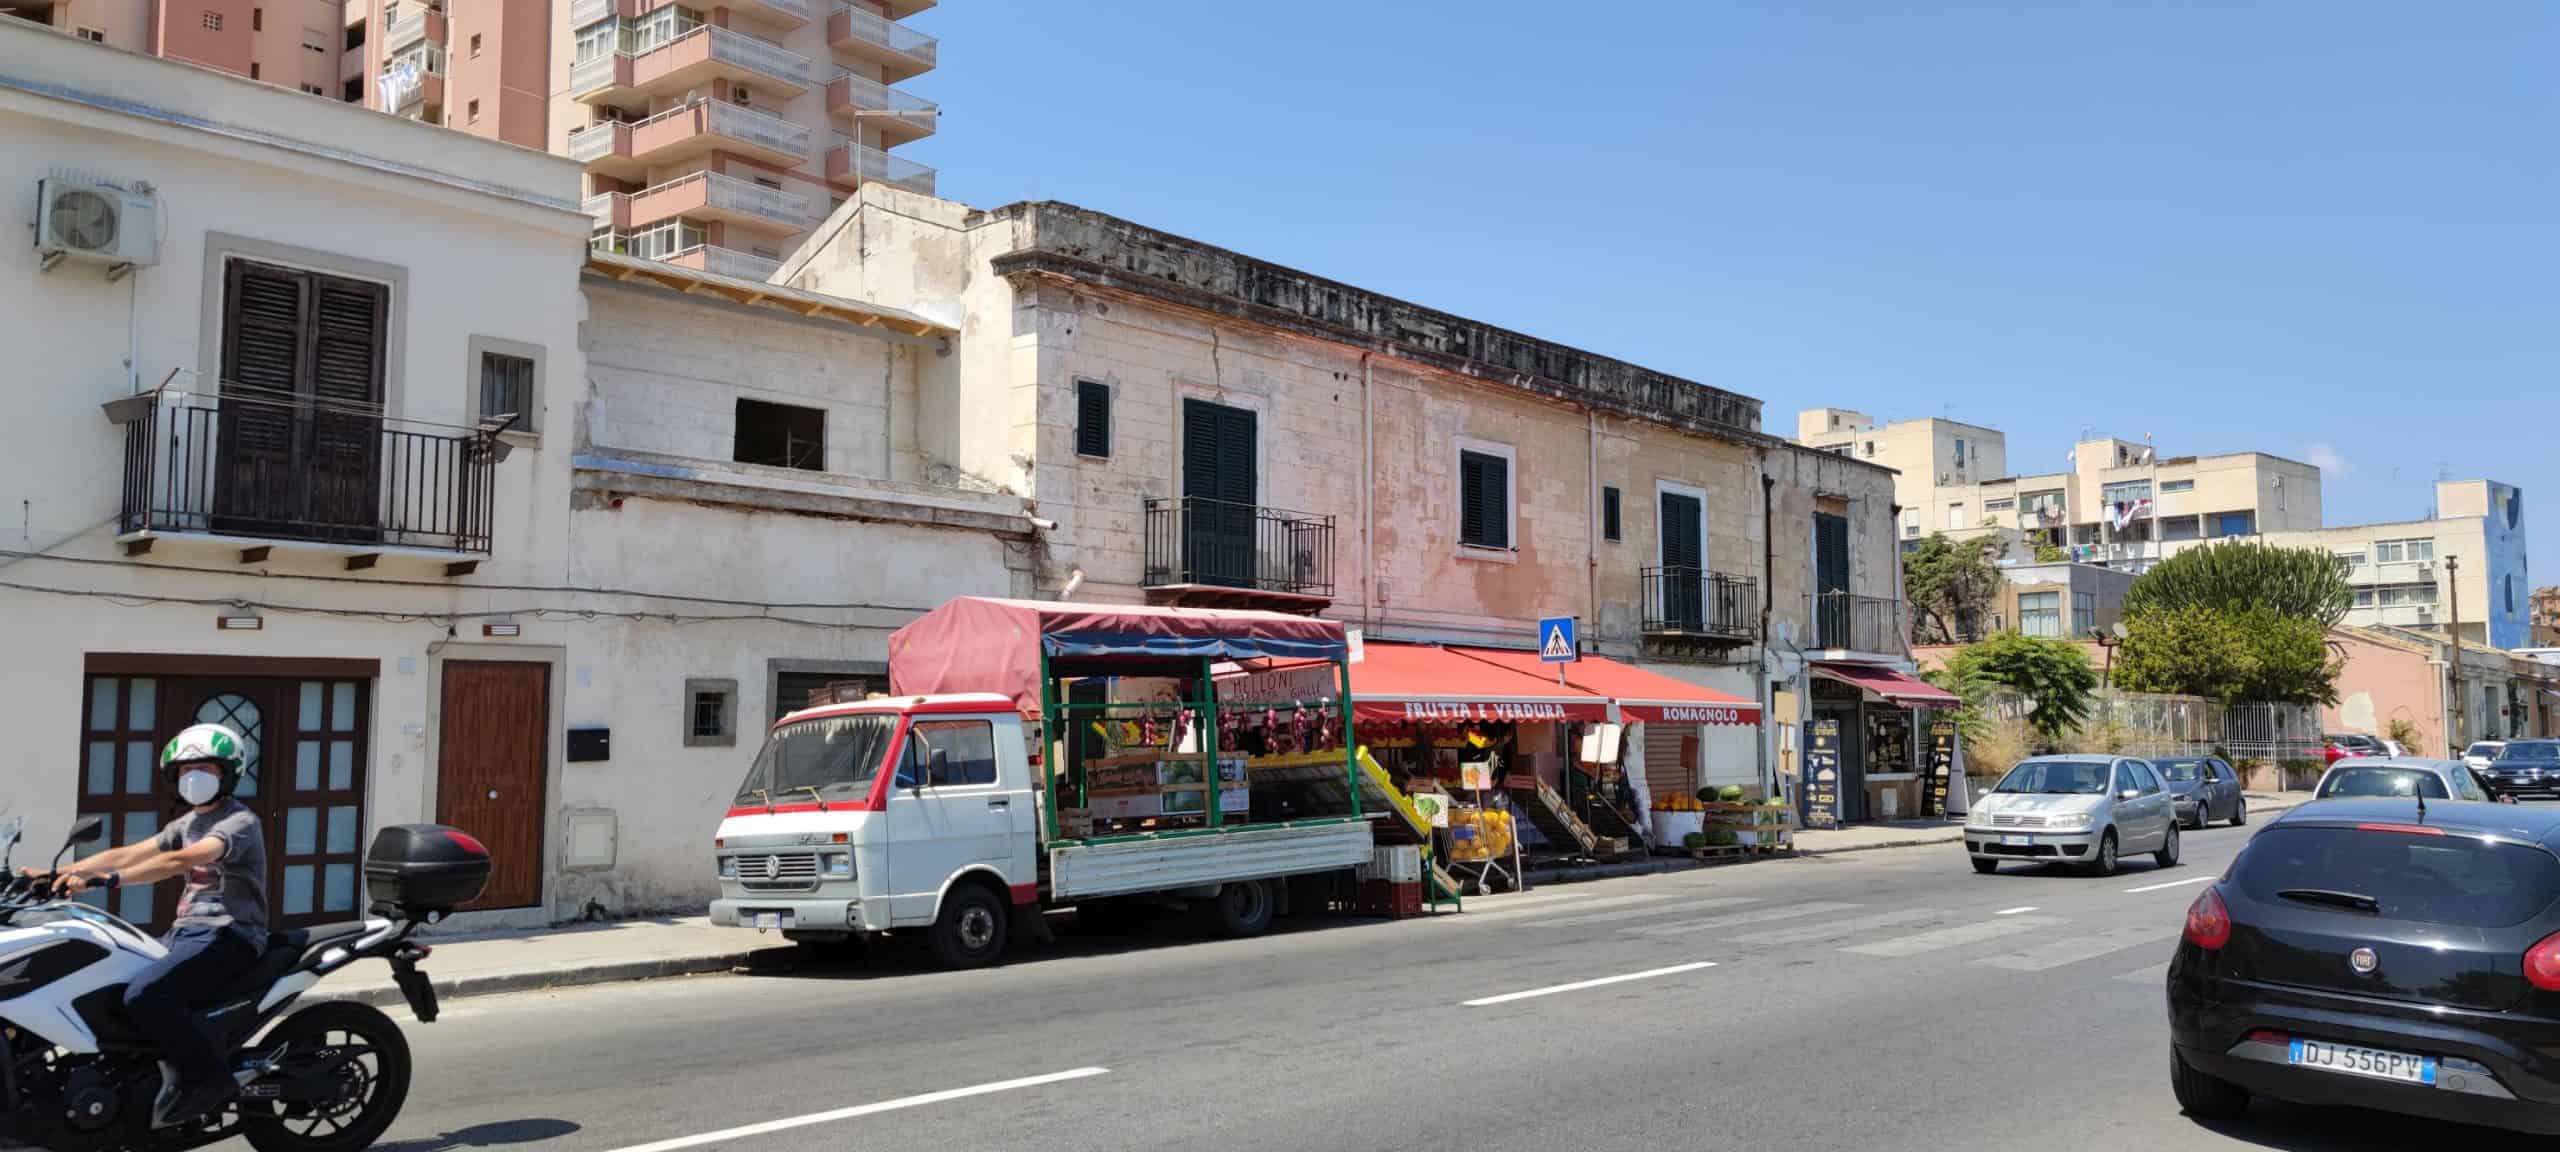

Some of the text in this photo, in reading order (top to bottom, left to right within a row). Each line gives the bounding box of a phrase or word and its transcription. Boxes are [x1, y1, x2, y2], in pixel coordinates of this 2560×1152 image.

[1404, 702, 1566, 718] FRUTTA E VERDURA
[1663, 707, 1738, 721] ROMAGNOLO
[2306, 1042, 2419, 1078] DJ 556PV
